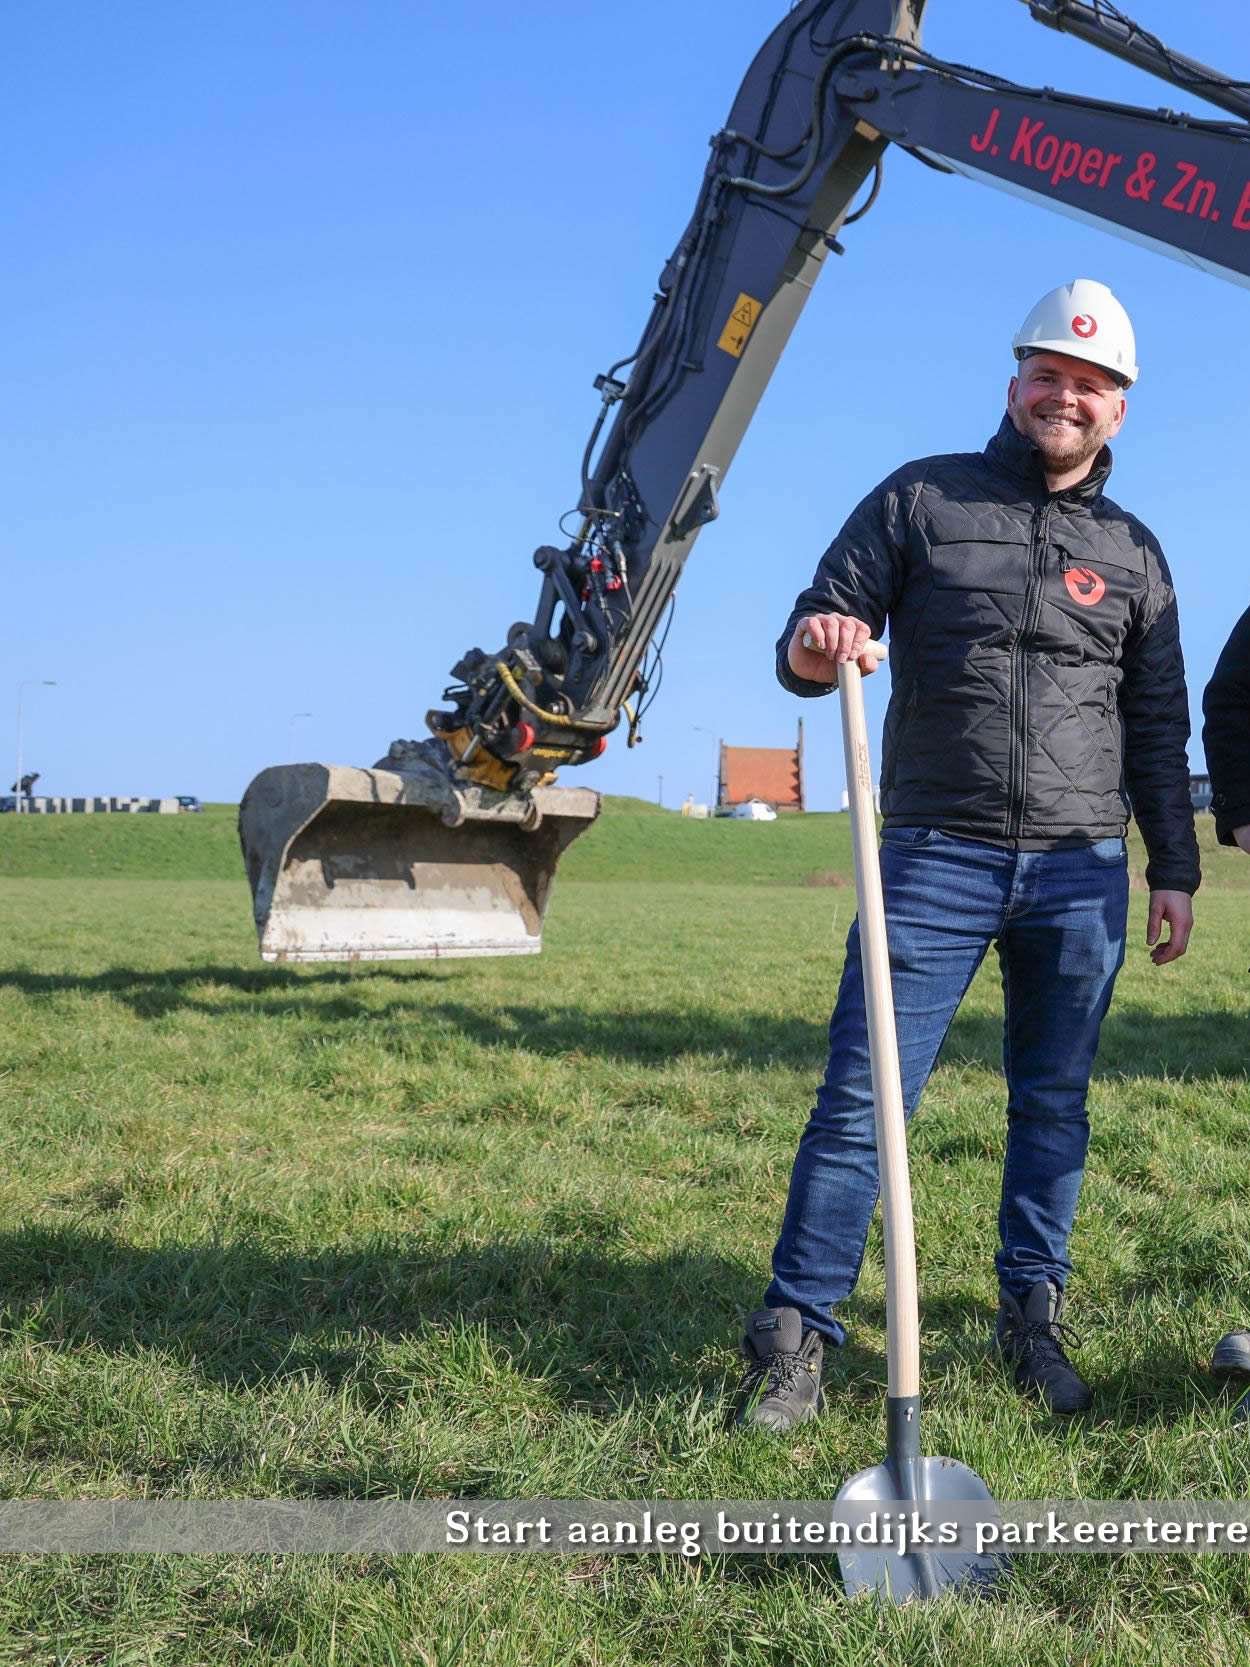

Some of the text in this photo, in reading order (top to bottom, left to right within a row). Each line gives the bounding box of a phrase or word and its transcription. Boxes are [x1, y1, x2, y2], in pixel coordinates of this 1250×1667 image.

[970, 108, 1000, 156] J.
[1009, 116, 1123, 188] Koper
[1124, 152, 1157, 202] &
[1162, 161, 1221, 222] Zn.
